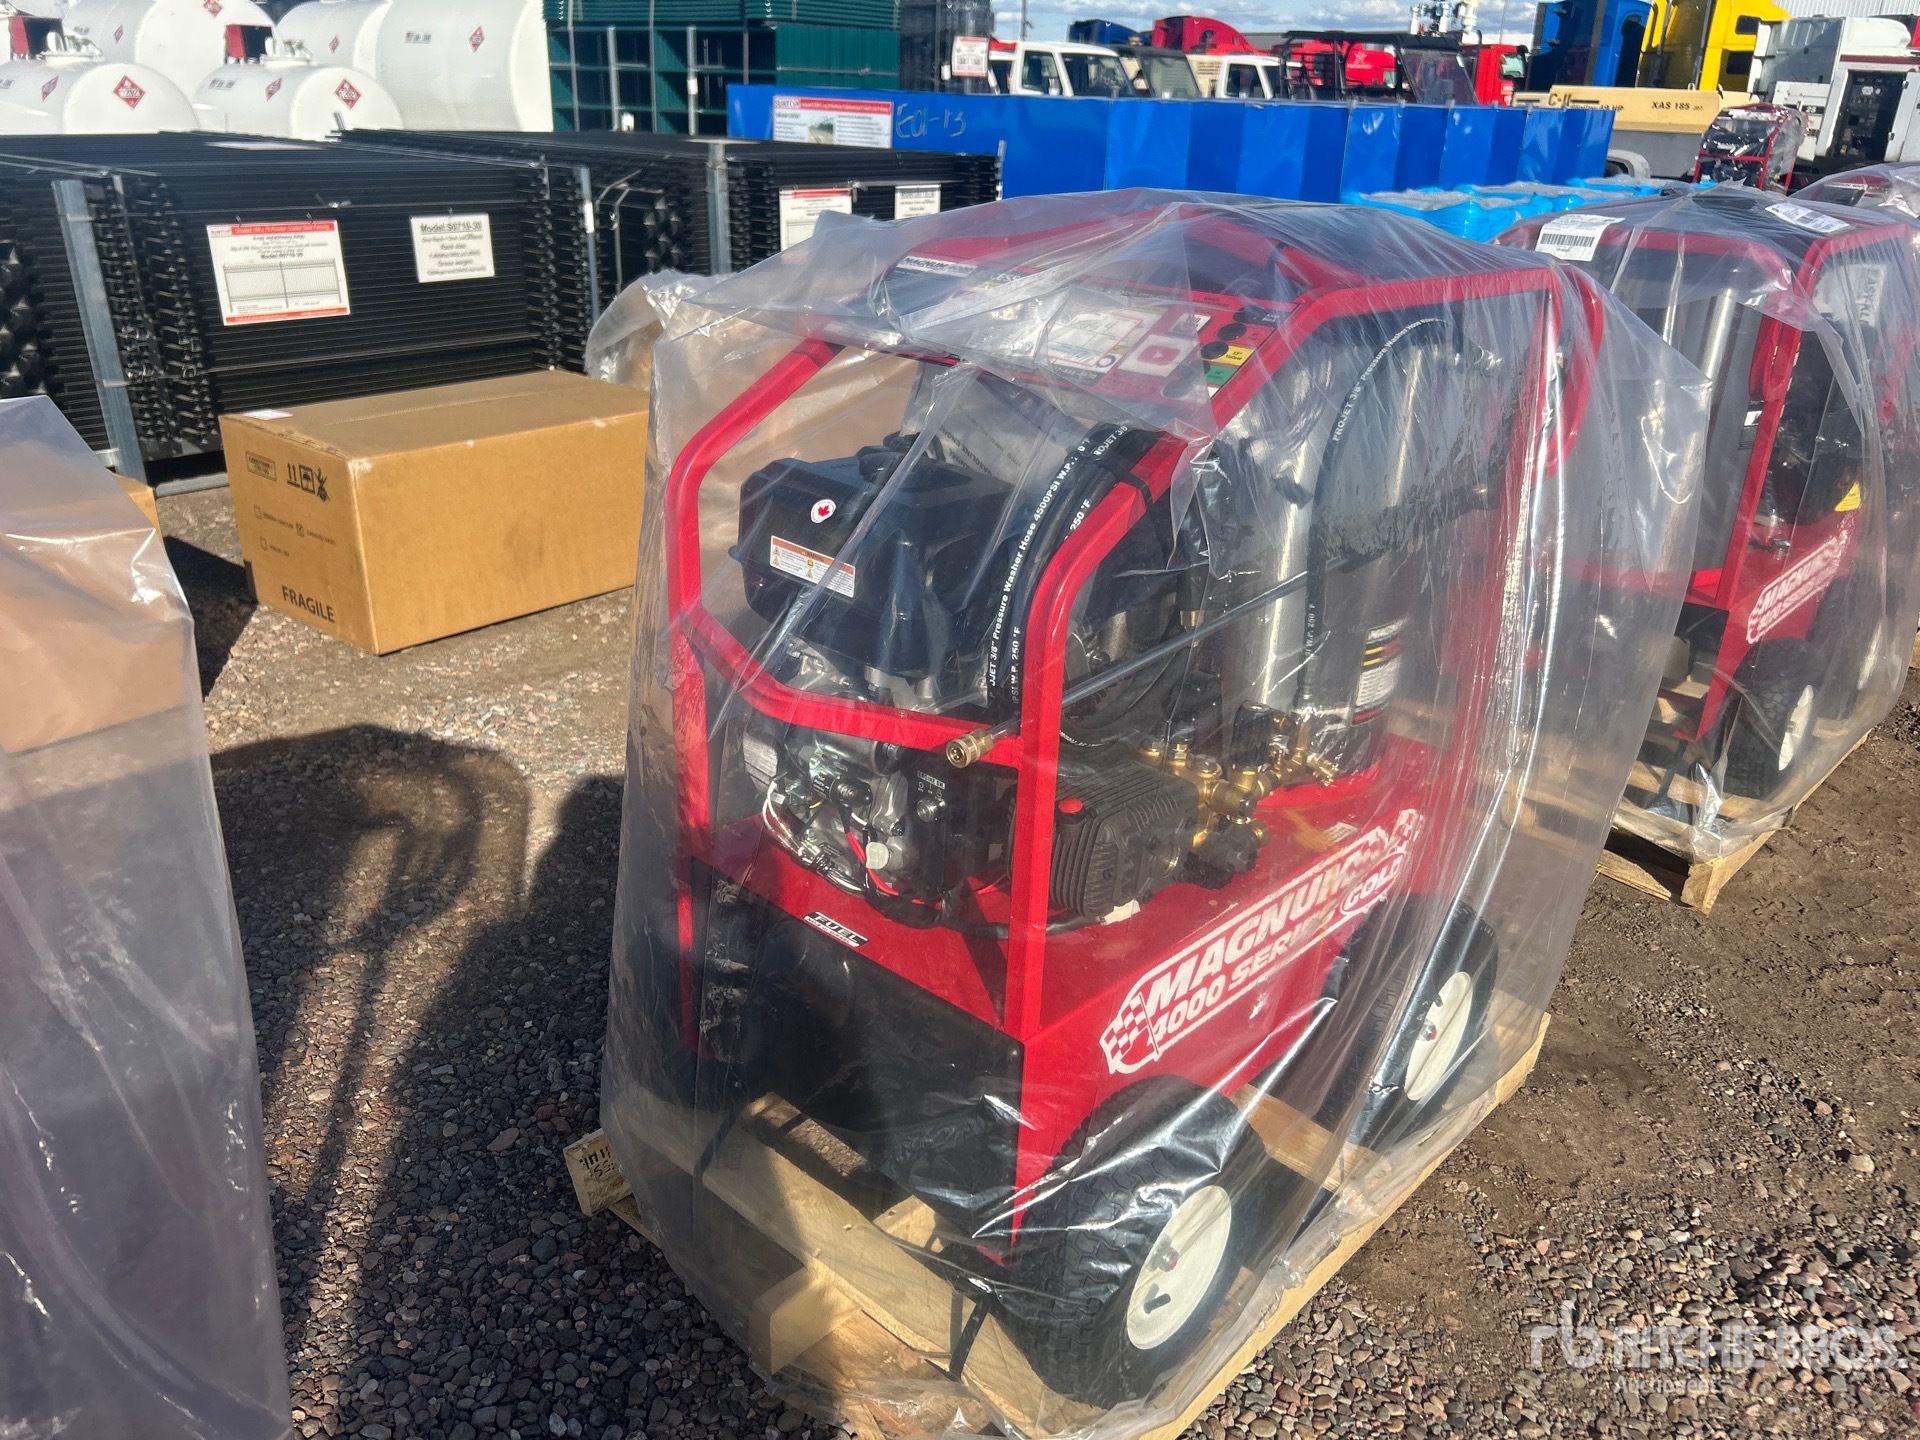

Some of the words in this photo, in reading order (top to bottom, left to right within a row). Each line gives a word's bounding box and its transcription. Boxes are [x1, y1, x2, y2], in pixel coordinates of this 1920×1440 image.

[1651, 101, 1671, 110] XAS
[1674, 102, 1690, 111] 185
[903, 257, 949, 271] MAGNUM
[1332, 402, 1354, 442] PROJET
[1360, 347, 1388, 381] Pressure
[1093, 433, 1117, 456] ROJET
[1069, 510, 1085, 532] 250
[992, 594, 1009, 640] Pressure
[1003, 551, 1024, 593] Washer
[1018, 522, 1036, 551] Hose
[1033, 480, 1061, 522] 4500PSI
[281, 585, 335, 623] FRAGILE
[1011, 641, 1020, 661] 250
[814, 915, 858, 943] FUEL
[1148, 973, 1227, 1044] 4000
